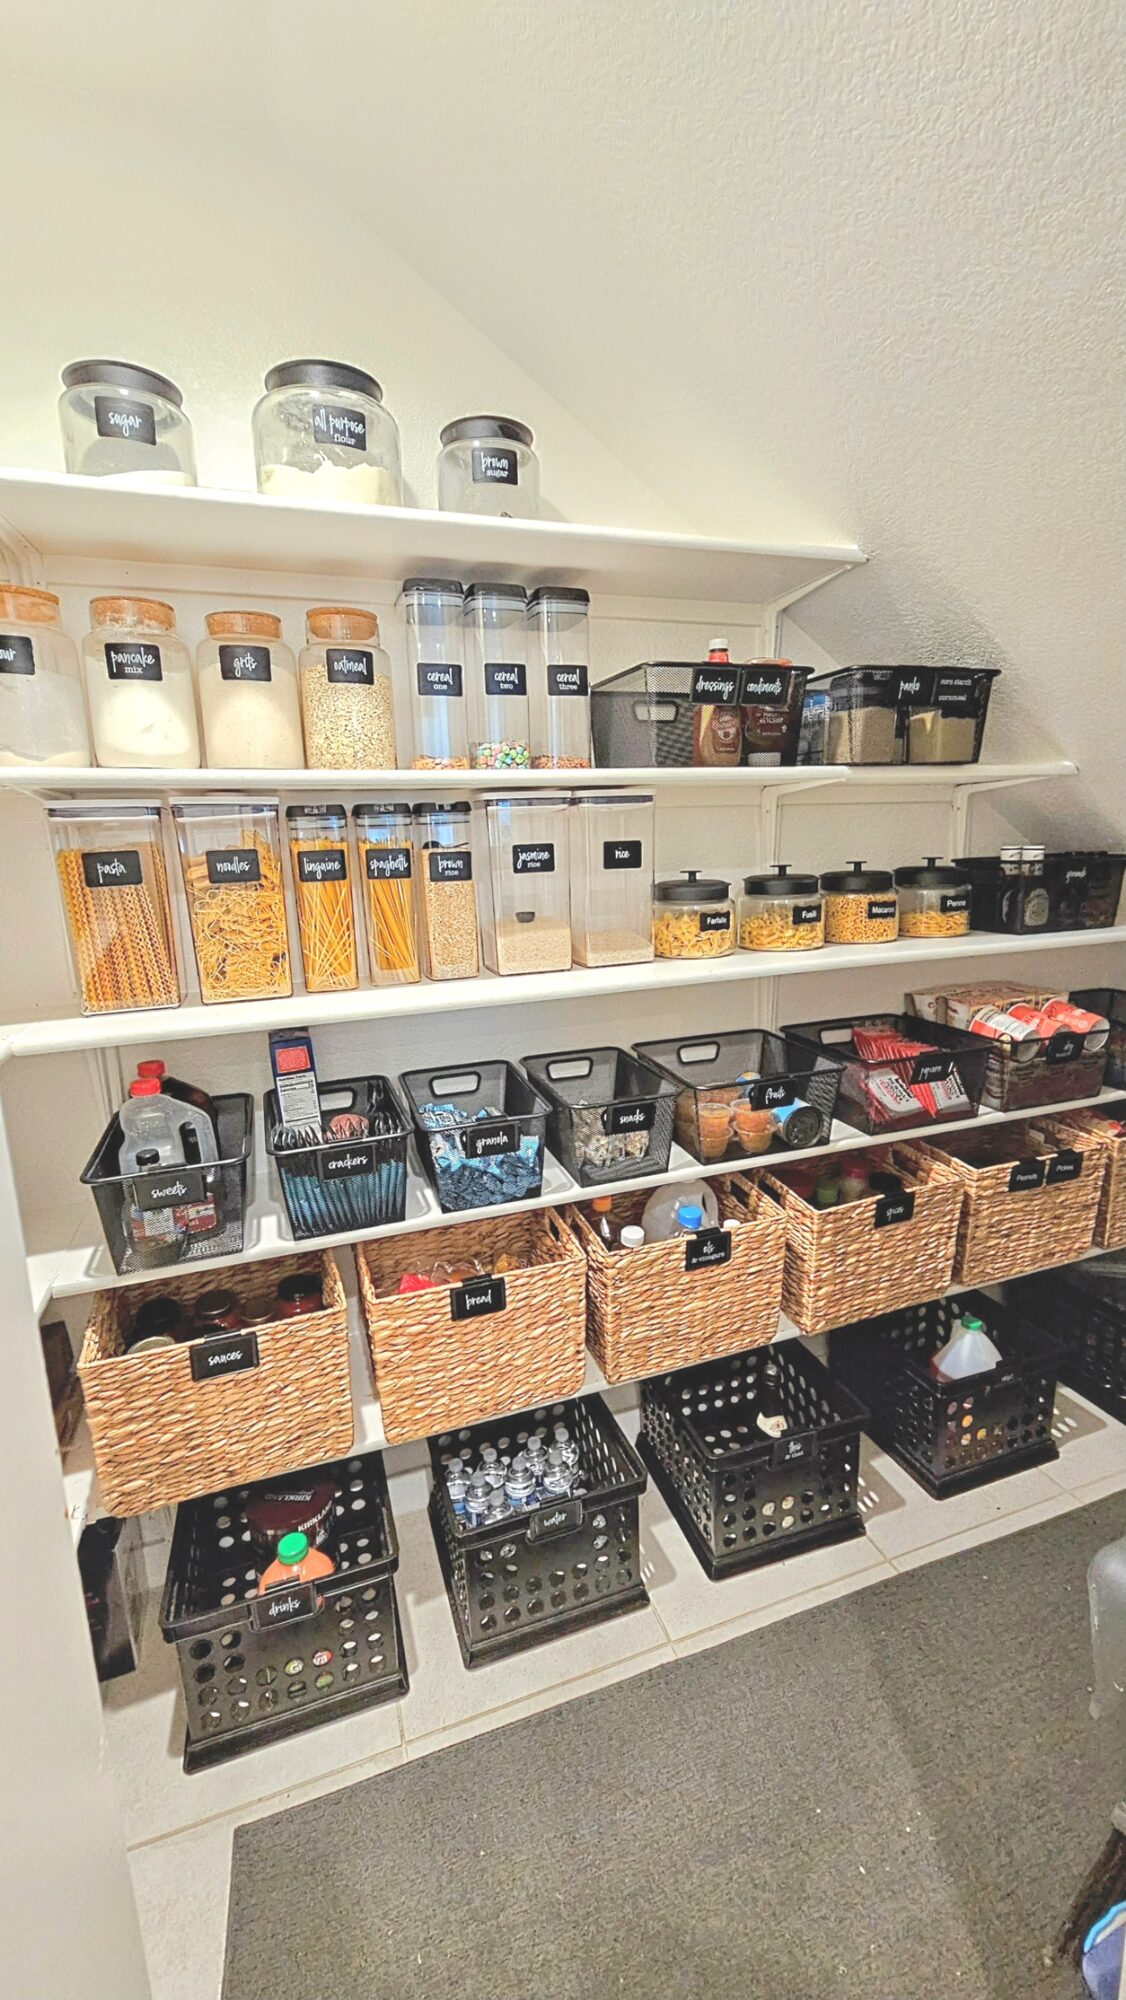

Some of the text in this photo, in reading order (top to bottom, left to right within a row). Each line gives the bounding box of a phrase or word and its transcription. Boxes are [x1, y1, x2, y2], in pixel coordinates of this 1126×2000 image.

[108, 411, 143, 437] sugar
[314, 408, 365, 437] all purpose
[333, 433, 356, 446] flour
[480, 451, 509, 472] brown
[486, 469, 509, 478] sugar
[110, 646, 156, 673] pancake
[233, 652, 257, 677] grits
[333, 655, 367, 676] oatmeal
[124, 665, 144, 674] mix
[426, 667, 453, 685] cereal
[493, 667, 520, 685] cereal
[556, 668, 580, 685] cereal
[432, 682, 448, 691] one
[558, 682, 579, 690] three
[695, 675, 735, 701] dressings
[517, 848, 550, 870] jasmine
[614, 846, 631, 860] rice
[97, 857, 127, 884] pasta
[216, 855, 251, 875] noodles
[369, 853, 409, 878] spaghetti
[437, 855, 465, 874] brown
[444, 869, 460, 877] rice
[527, 861, 542, 869] rice
[619, 1108, 646, 1125] snacks
[475, 1130, 509, 1155] granola
[328, 1153, 369, 1170] crackers
[150, 1180, 188, 1200] sweets
[465, 1288, 492, 1311] bread
[207, 1350, 243, 1367] sauces
[268, 1596, 302, 1617] drinks
